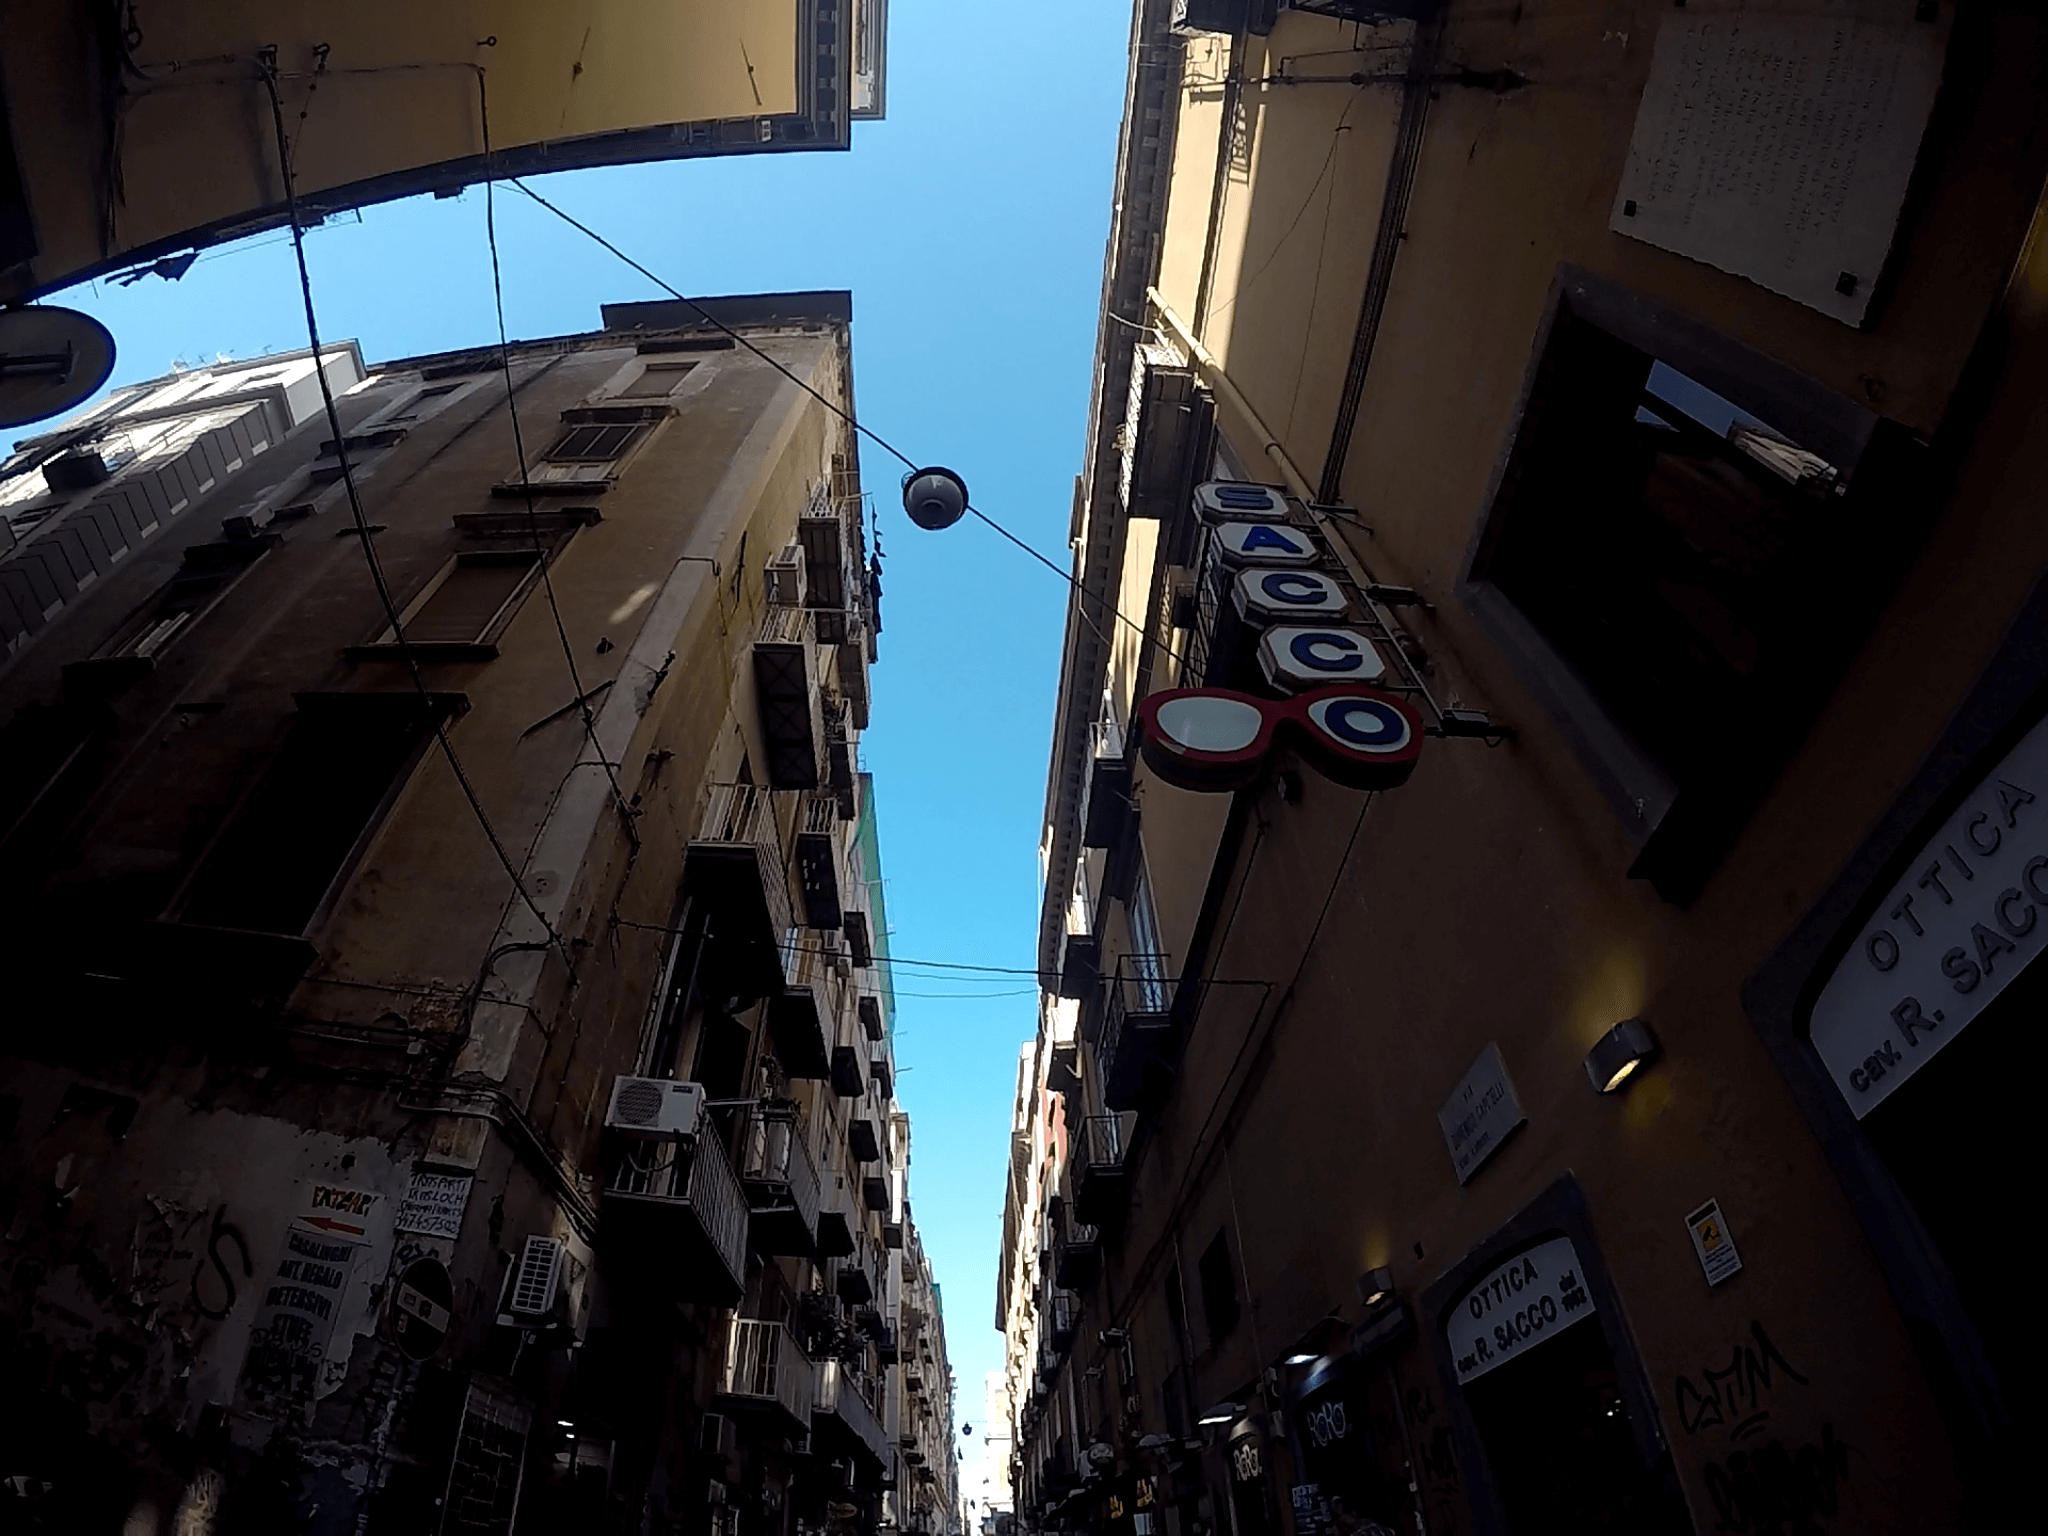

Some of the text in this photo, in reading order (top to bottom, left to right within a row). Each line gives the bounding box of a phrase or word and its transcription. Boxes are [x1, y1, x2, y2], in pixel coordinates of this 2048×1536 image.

[1214, 486, 1405, 745] SACCO
[1865, 777, 2036, 974] OTTICA
[1849, 1038, 1902, 1093] cav.
[1889, 994, 1946, 1048] R.
[1469, 1257, 1539, 1319] OTTICA
[1475, 1336, 1495, 1363] R.
[1494, 1295, 1557, 1351] SACCO
